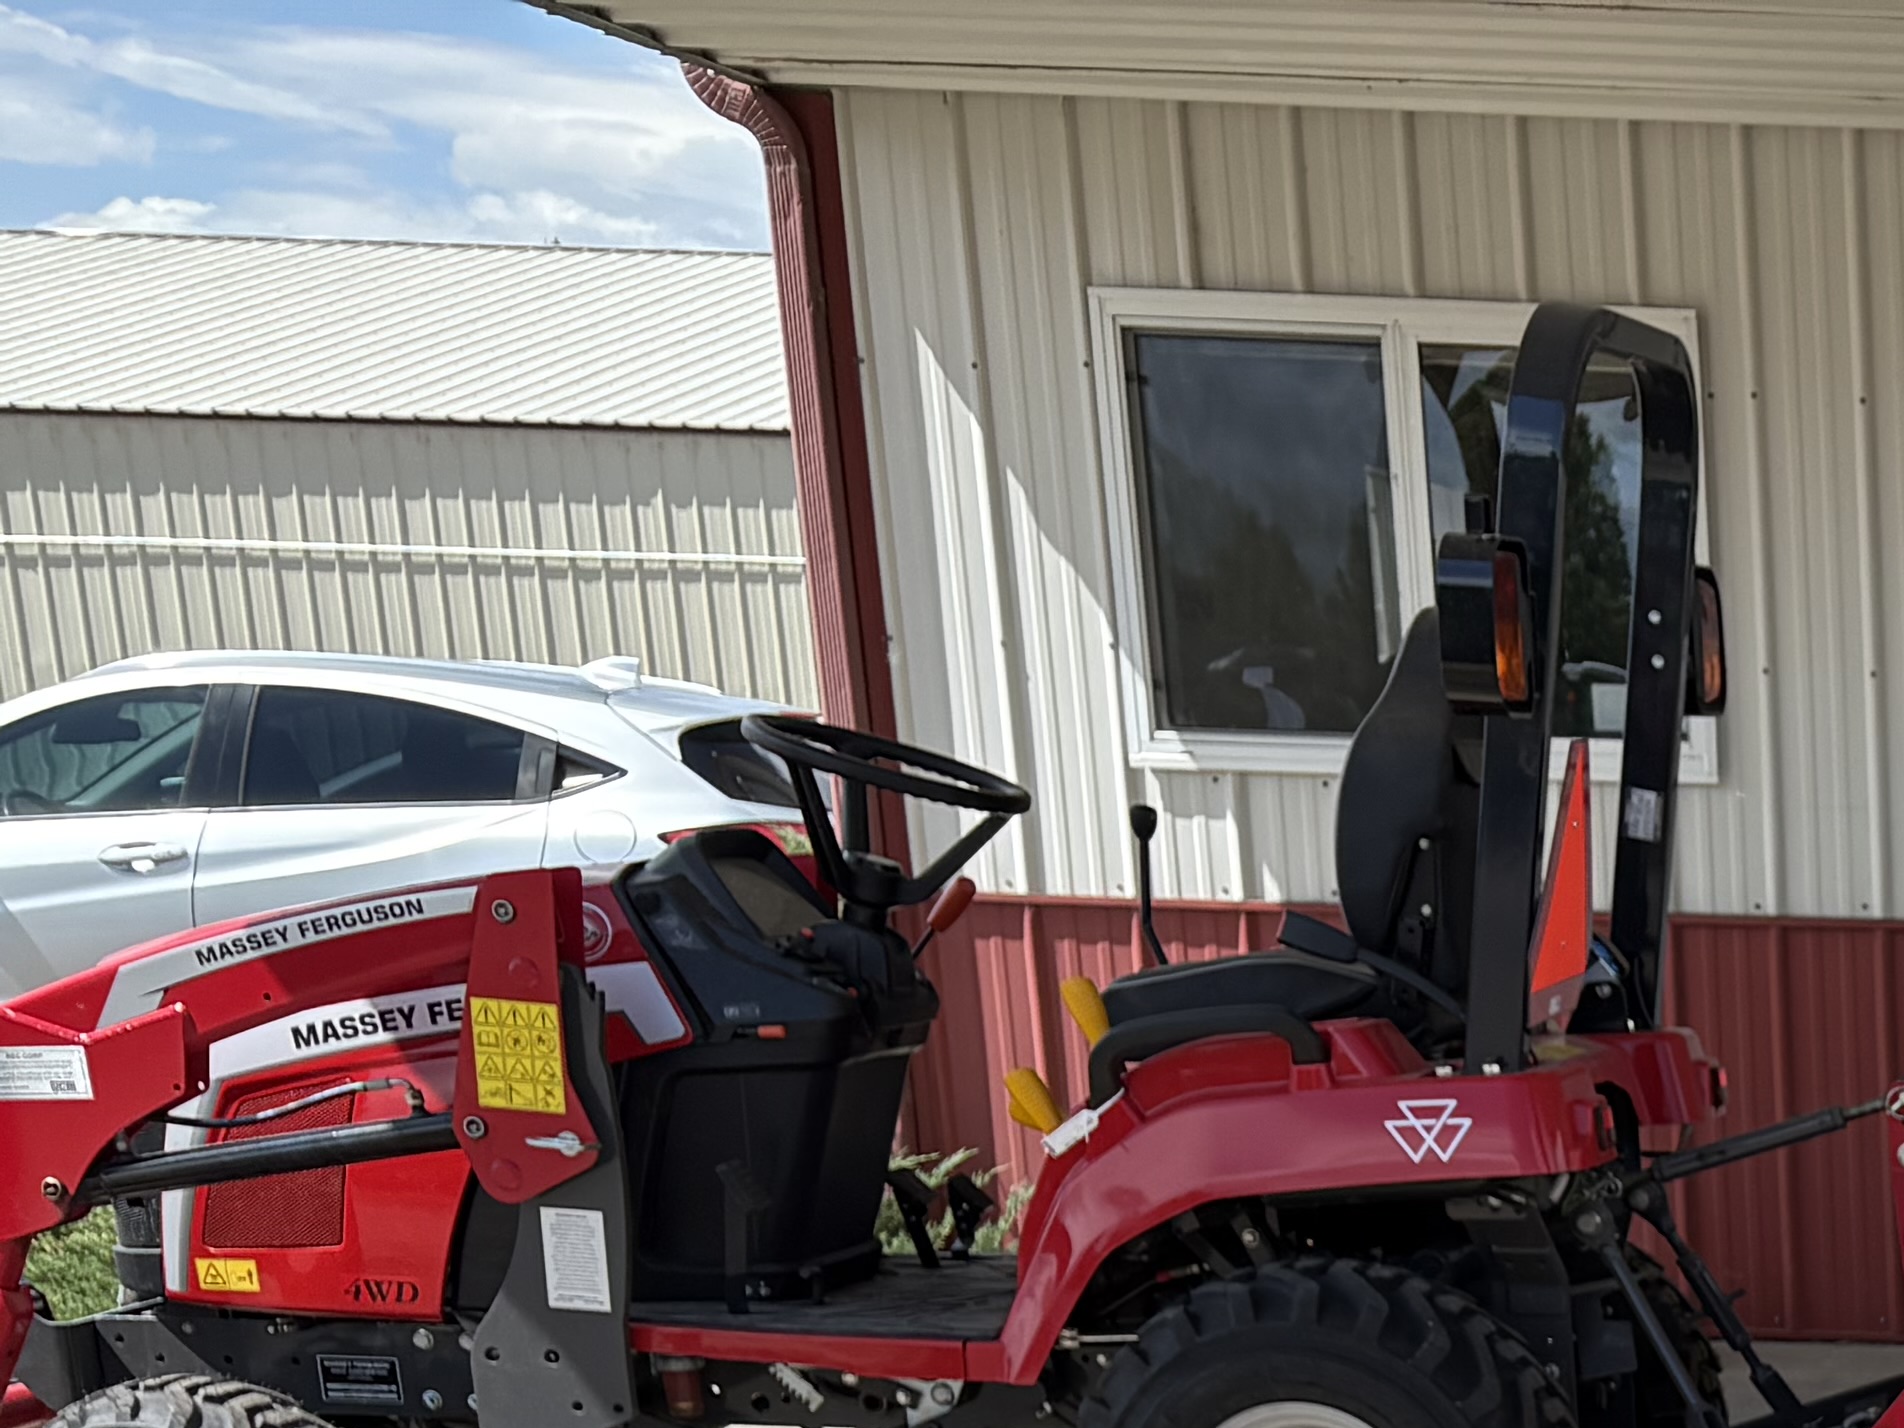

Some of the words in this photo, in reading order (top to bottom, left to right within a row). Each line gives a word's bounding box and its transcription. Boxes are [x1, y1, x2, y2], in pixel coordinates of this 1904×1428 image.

[195, 925, 290, 966] MASSEY
[297, 898, 424, 940] FERGUSON
[291, 1003, 415, 1050] MASSEY
